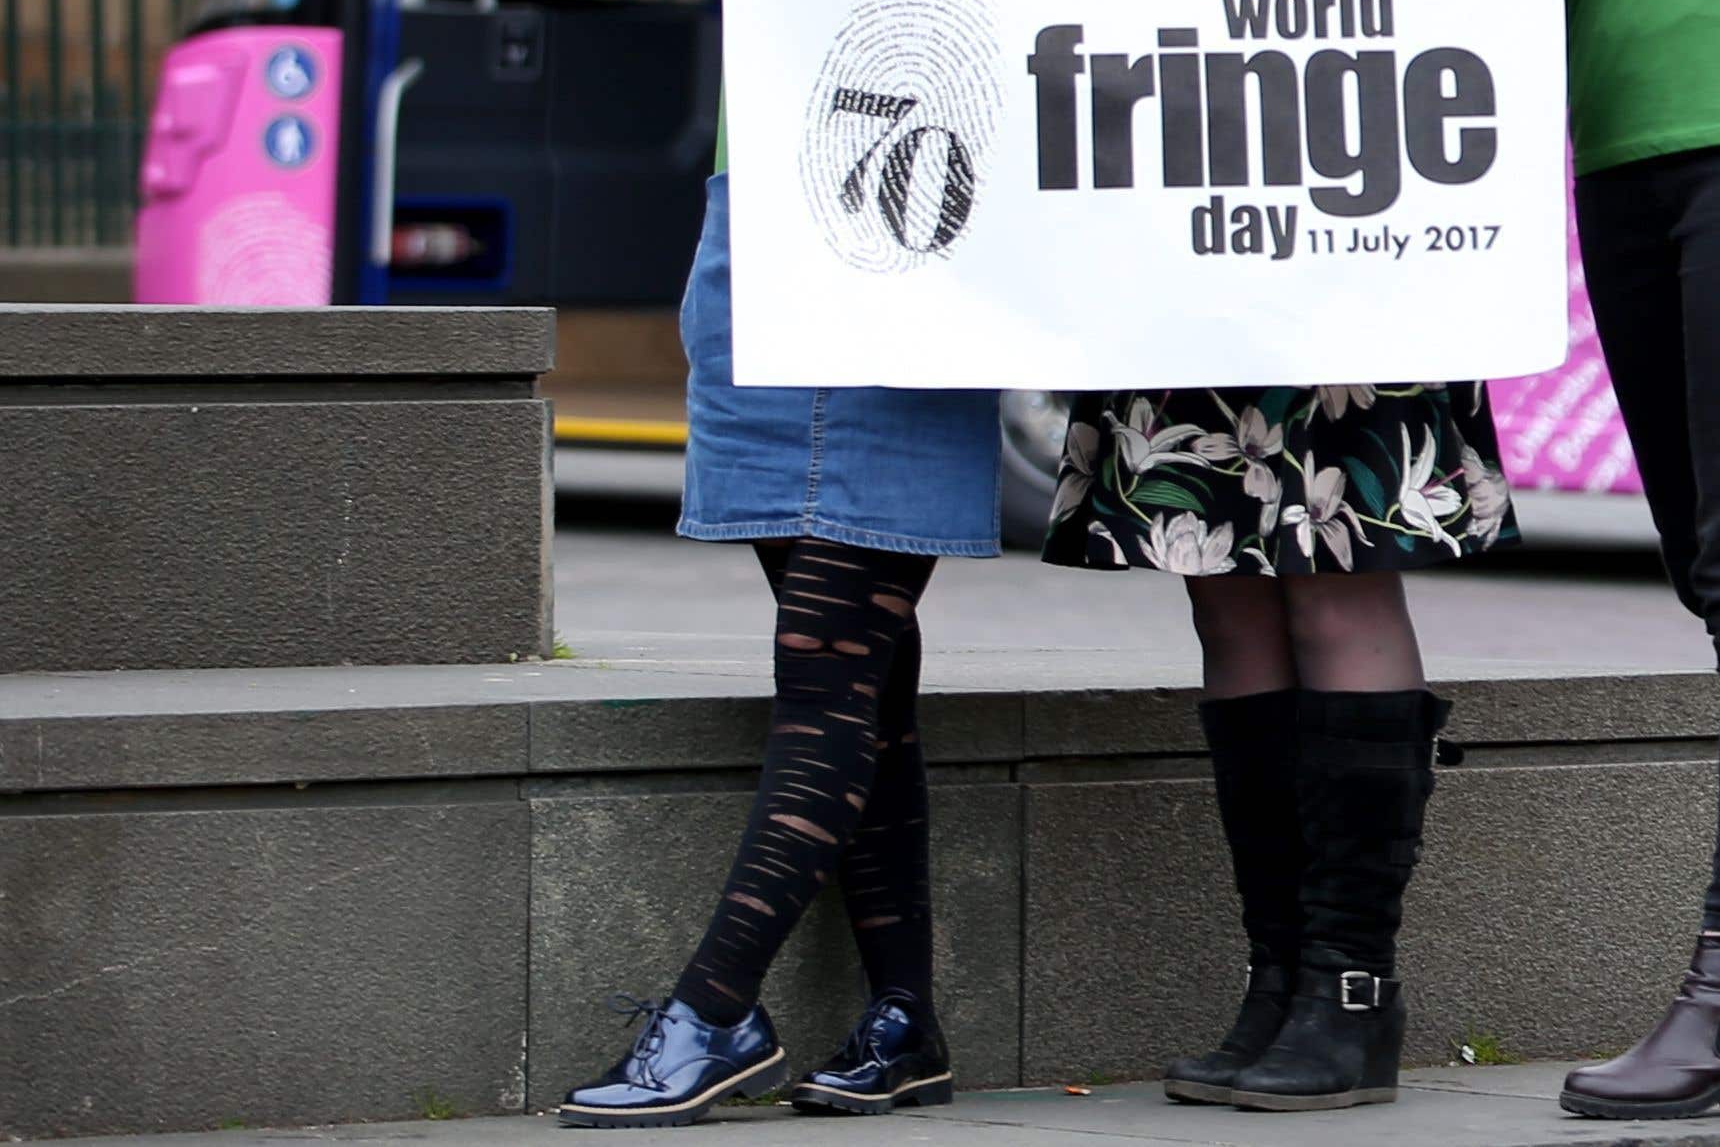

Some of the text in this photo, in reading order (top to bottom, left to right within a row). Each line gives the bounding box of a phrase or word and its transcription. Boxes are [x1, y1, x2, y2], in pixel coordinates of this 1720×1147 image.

[826, 86, 977, 255] 70
[1027, 24, 1498, 218] fringe
[1191, 195, 1502, 261] day 11 July 2017
